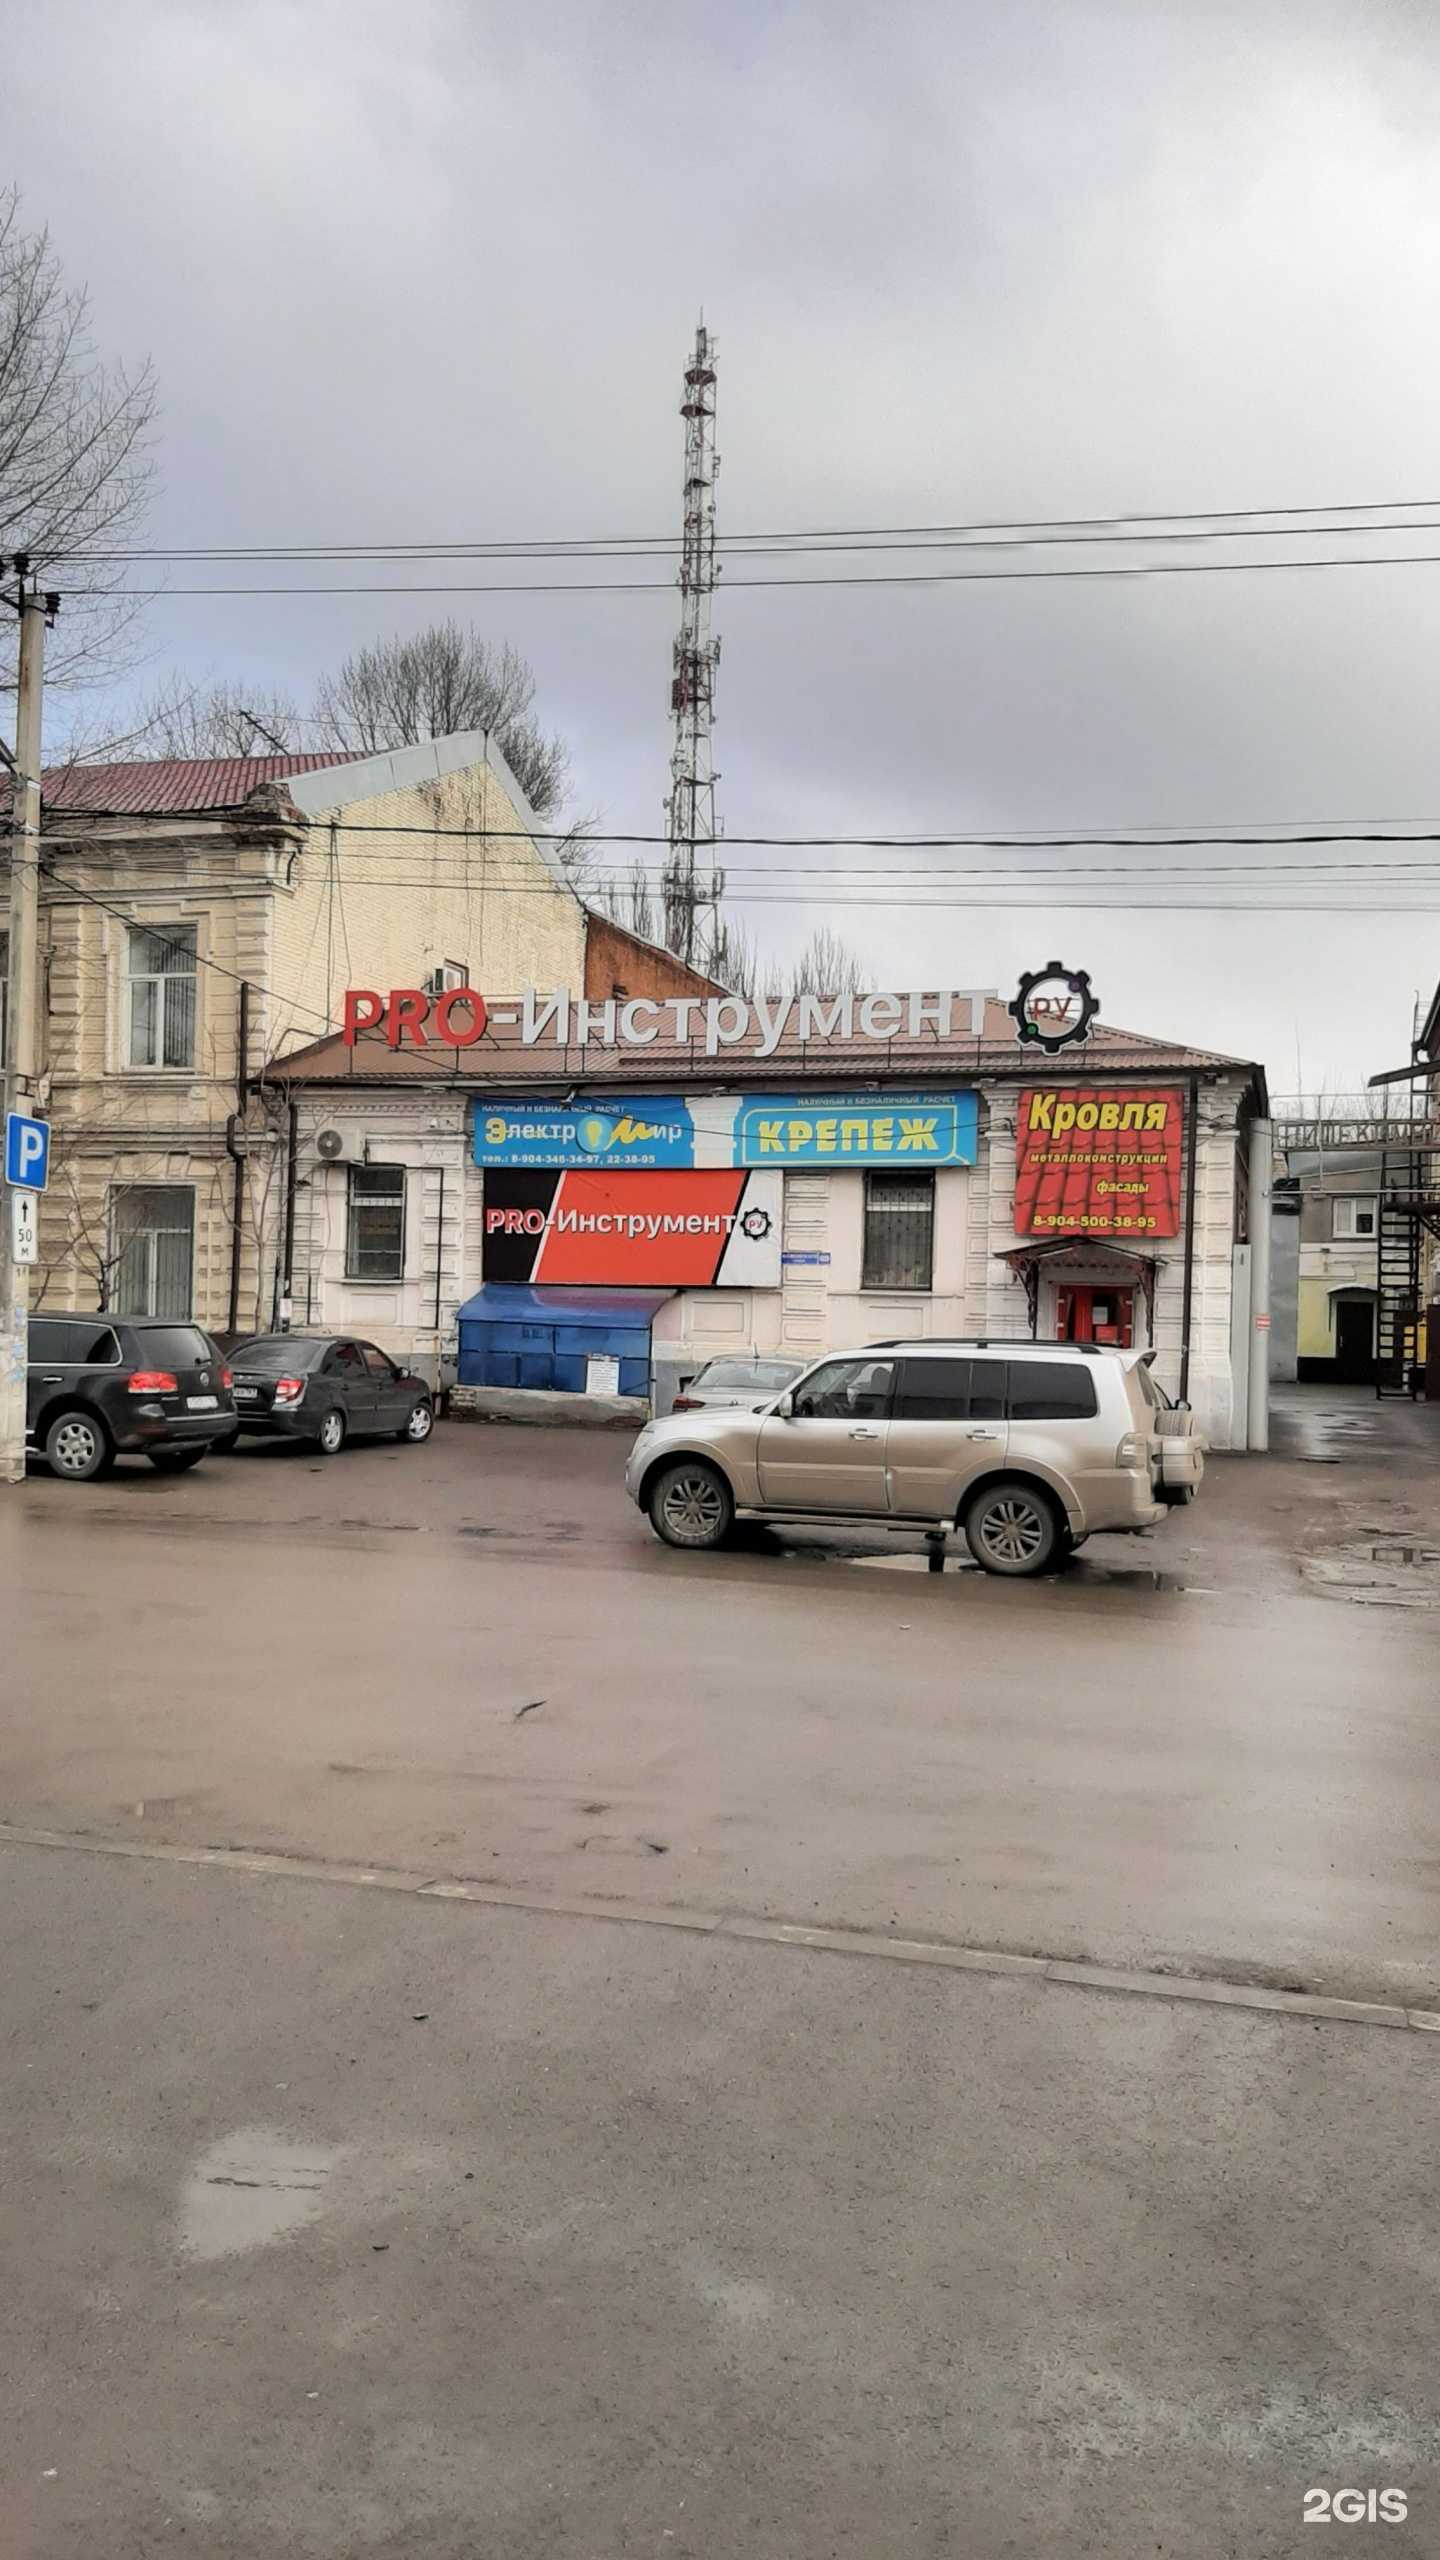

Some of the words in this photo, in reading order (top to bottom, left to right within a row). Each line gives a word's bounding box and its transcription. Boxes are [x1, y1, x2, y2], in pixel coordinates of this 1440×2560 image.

[1028, 1093, 1168, 1139] Кровля
[758, 1117, 940, 1152] КРЕПЕЖ
[20, 1125, 44, 1178] P
[1030, 1153, 1168, 1165] металлоконструкции
[1096, 1180, 1149, 1196] фасады
[1033, 1215, 1157, 1229] 8-904-500-38-95
[18, 1228, 33, 1242] 50
